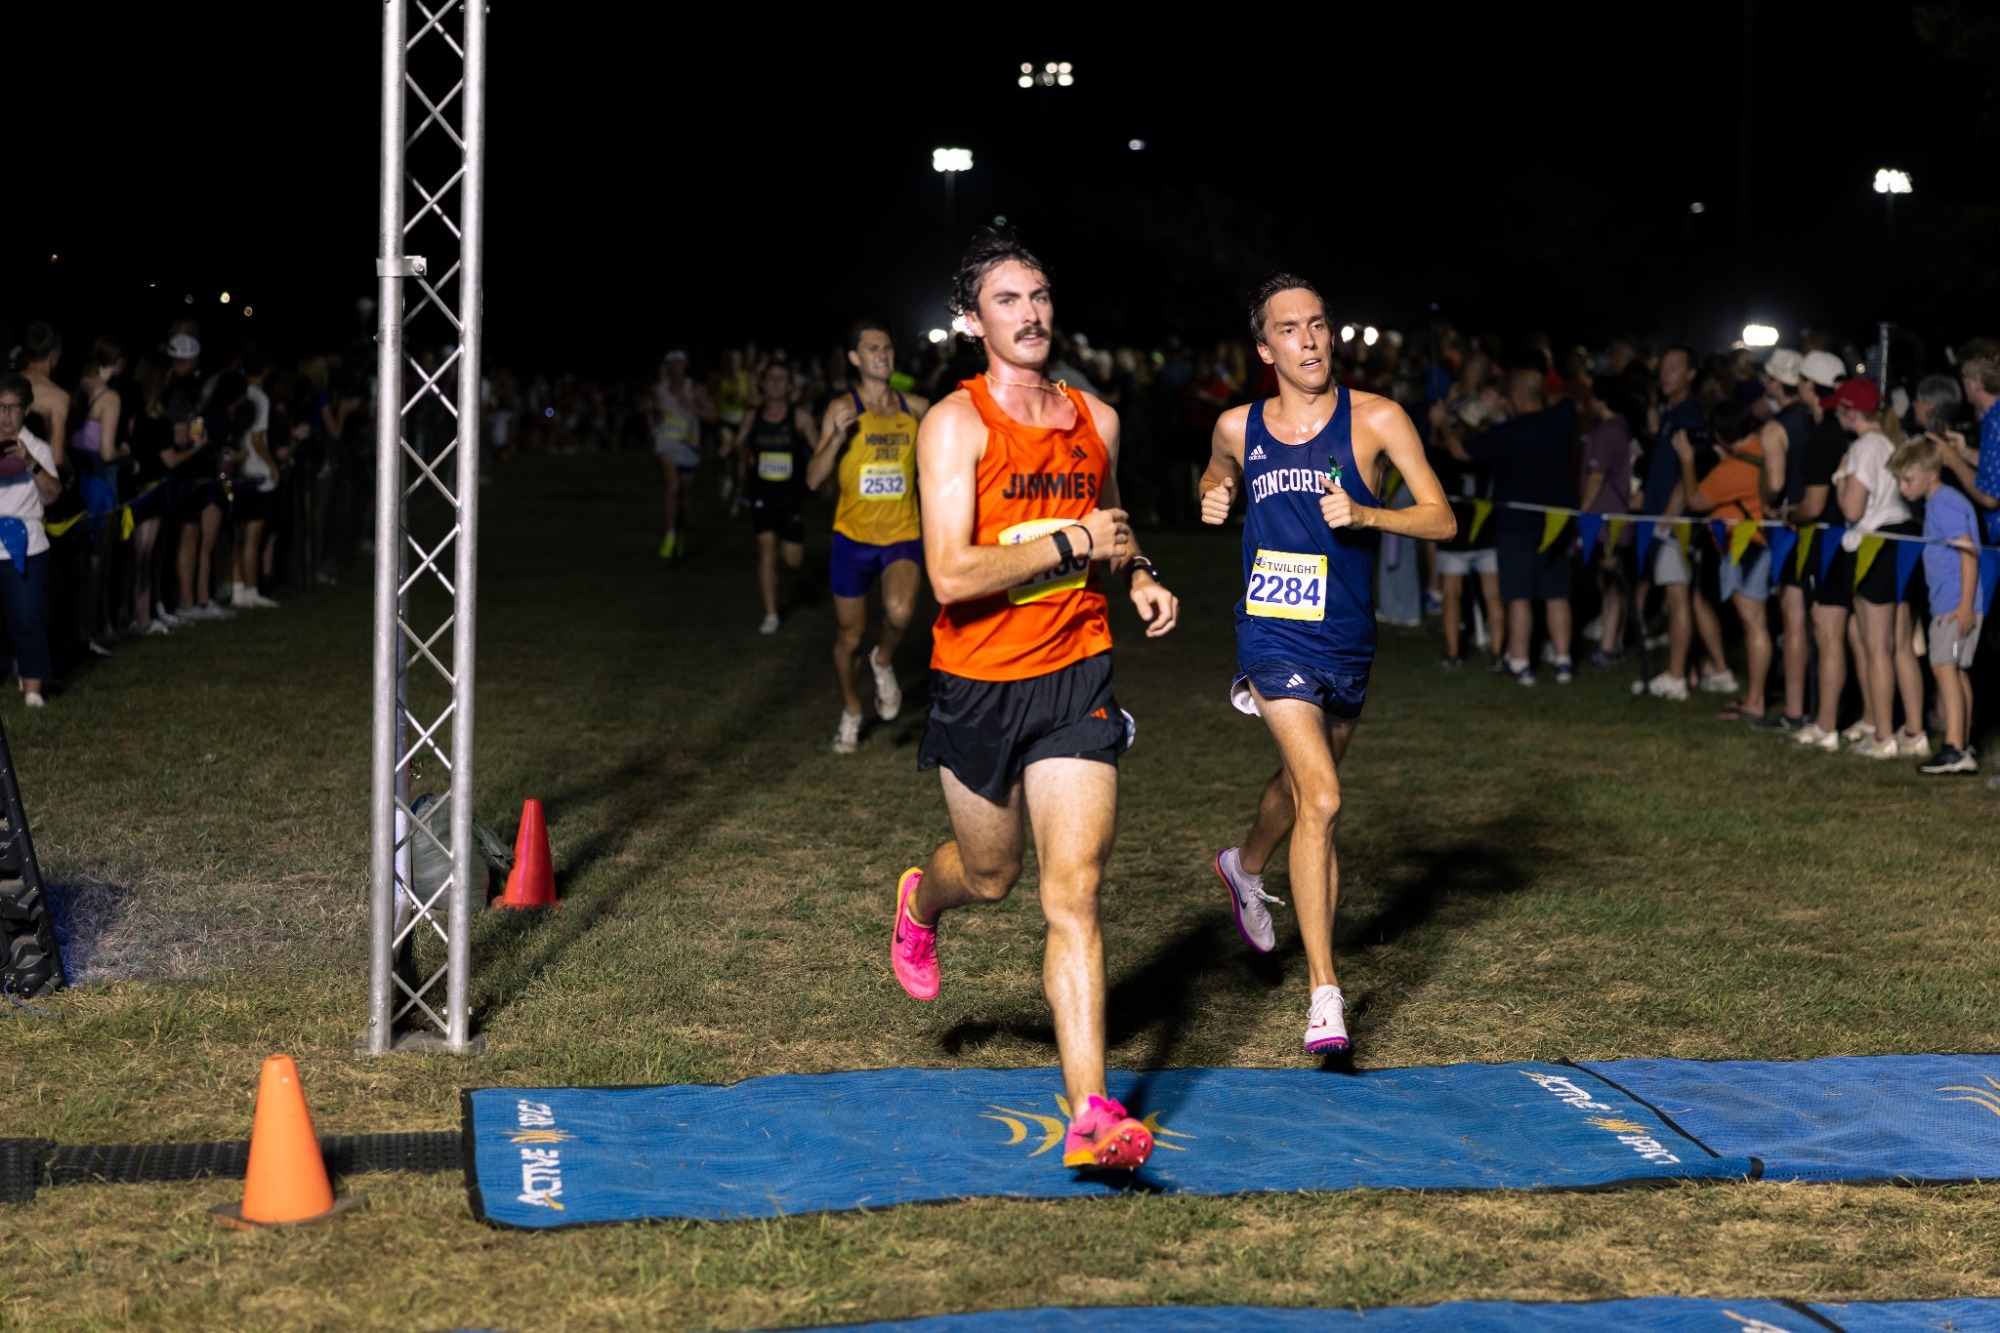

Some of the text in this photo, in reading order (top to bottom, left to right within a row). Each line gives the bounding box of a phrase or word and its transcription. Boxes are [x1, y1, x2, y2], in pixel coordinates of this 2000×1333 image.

[864, 476, 904, 495] 2532
[1002, 472, 1097, 499] JIMMIES
[1252, 468, 1342, 504] CONCORD
[1267, 561, 1318, 575] TWILIGHT
[1250, 573, 1321, 606] 2284
